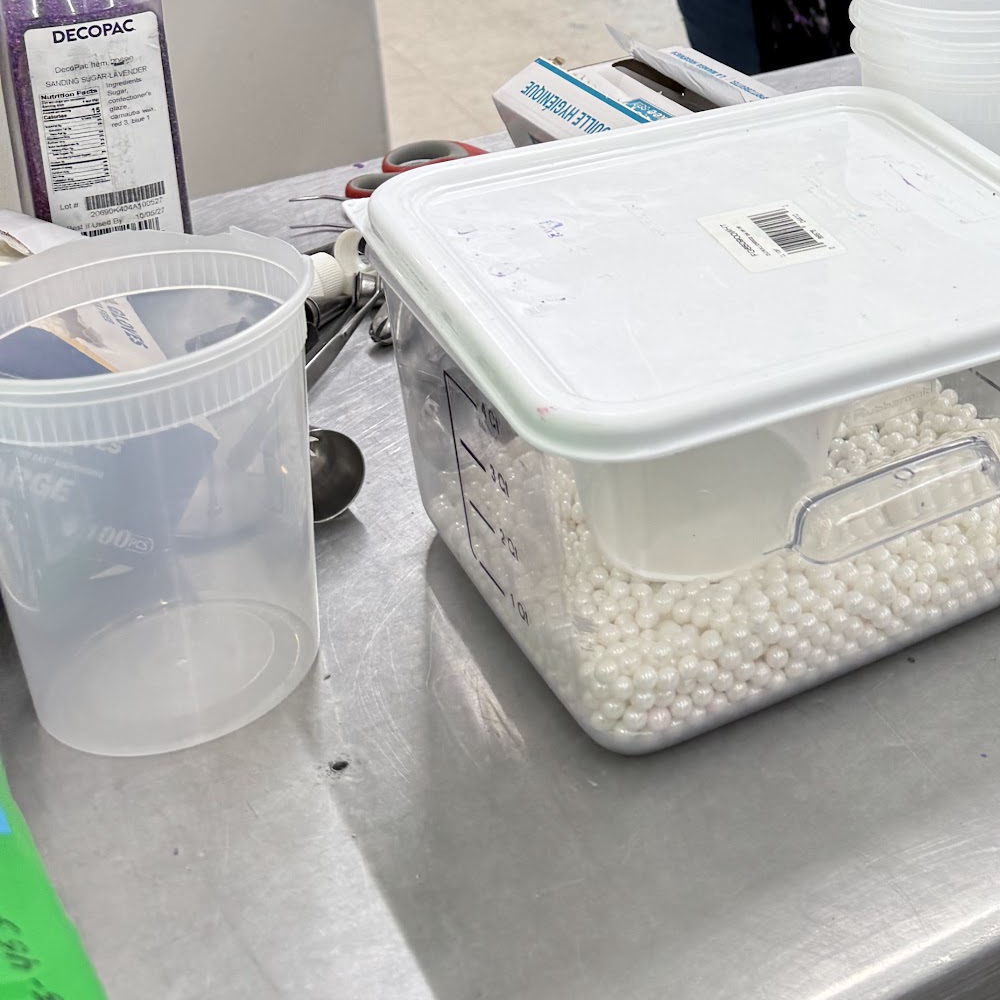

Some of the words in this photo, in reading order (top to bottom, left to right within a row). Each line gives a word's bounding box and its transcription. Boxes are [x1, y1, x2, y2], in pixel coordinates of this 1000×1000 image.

[52, 19, 135, 44] DECOPAC
[45, 78, 80, 88] SANDING
[81, 65, 148, 84] SUGAR-LAVENDER
[55, 63, 89, 74] DecoPac
[41, 92, 75, 101] Nutrition
[76, 88, 98, 96] Facts
[520, 81, 580, 122] HYGIÉNIQUE
[135, 207, 165, 219] 10/05/27
